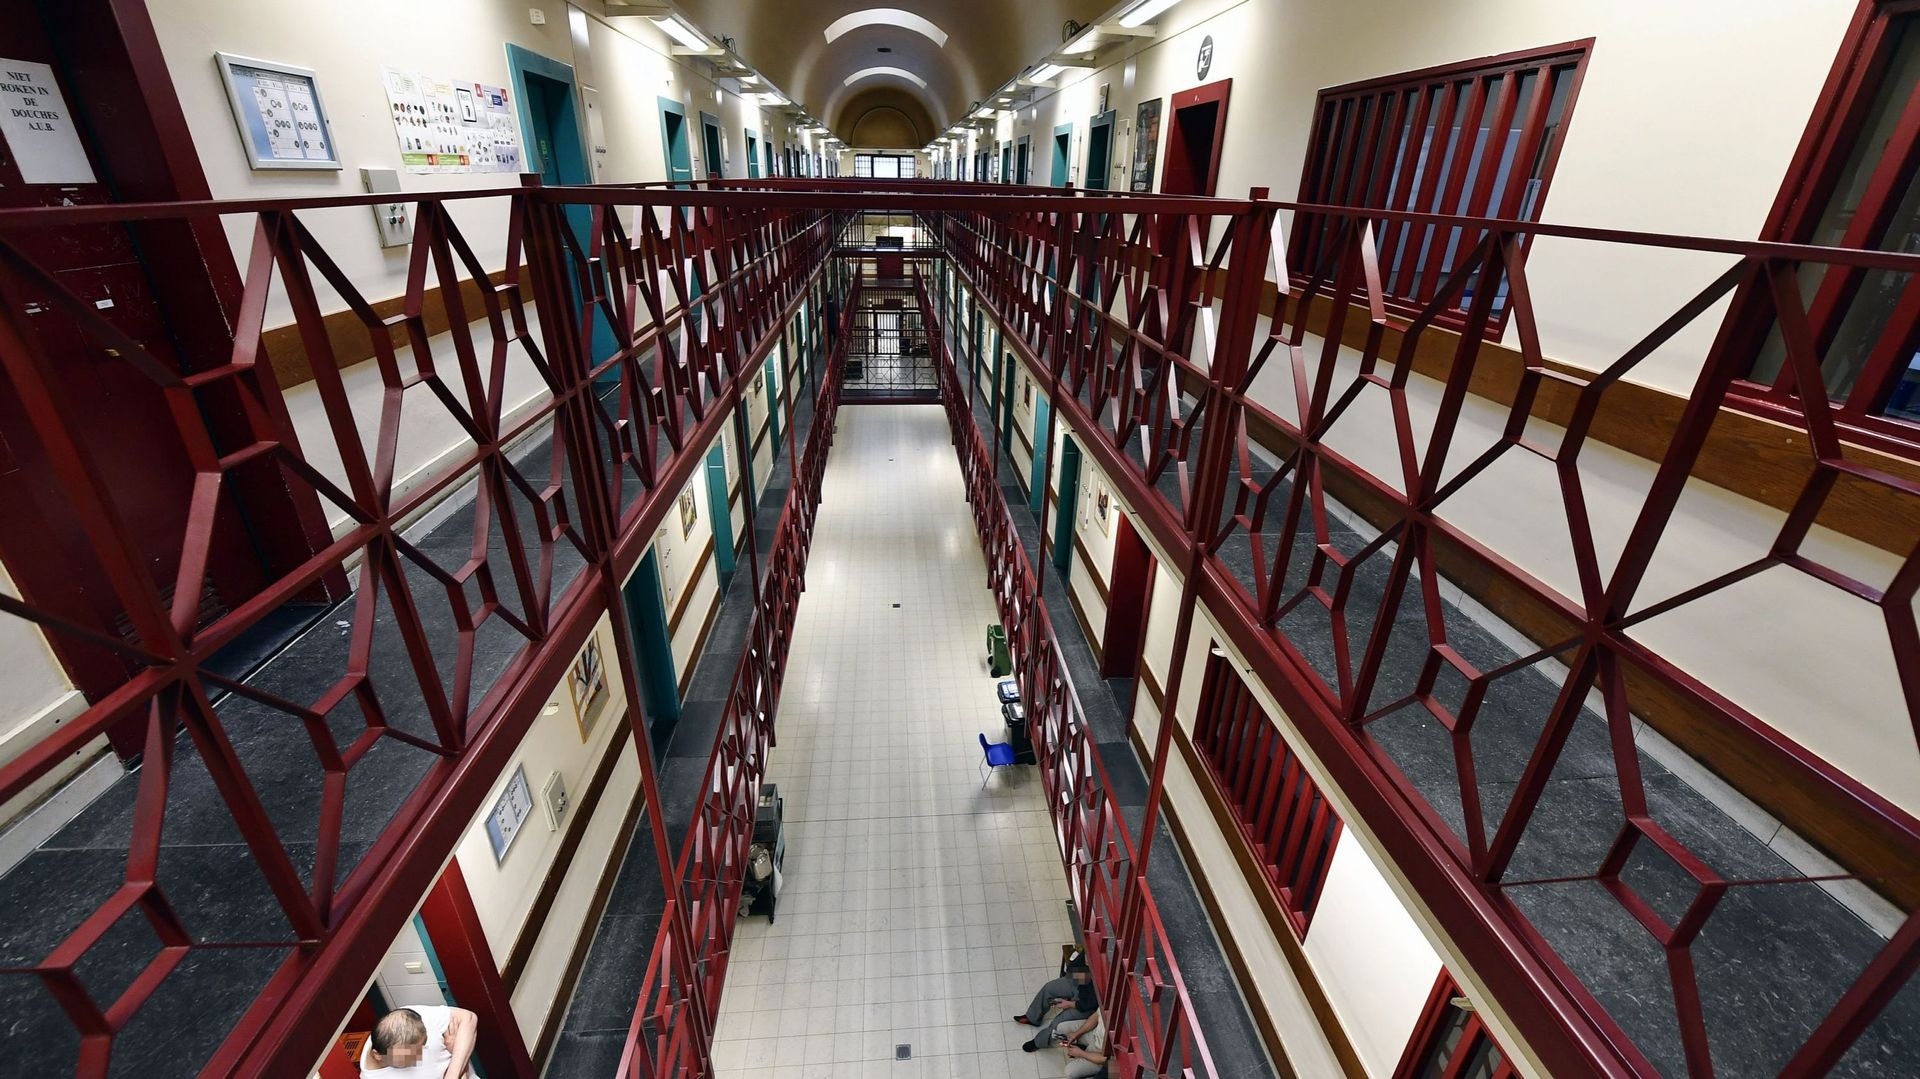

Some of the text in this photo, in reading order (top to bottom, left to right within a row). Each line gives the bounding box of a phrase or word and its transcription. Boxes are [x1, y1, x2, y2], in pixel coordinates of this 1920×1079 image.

[7, 71, 31, 82] NIET
[0, 83, 49, 95] ROKEN IN
[23, 97, 39, 107] DE
[11, 109, 59, 120] DOUCHES
